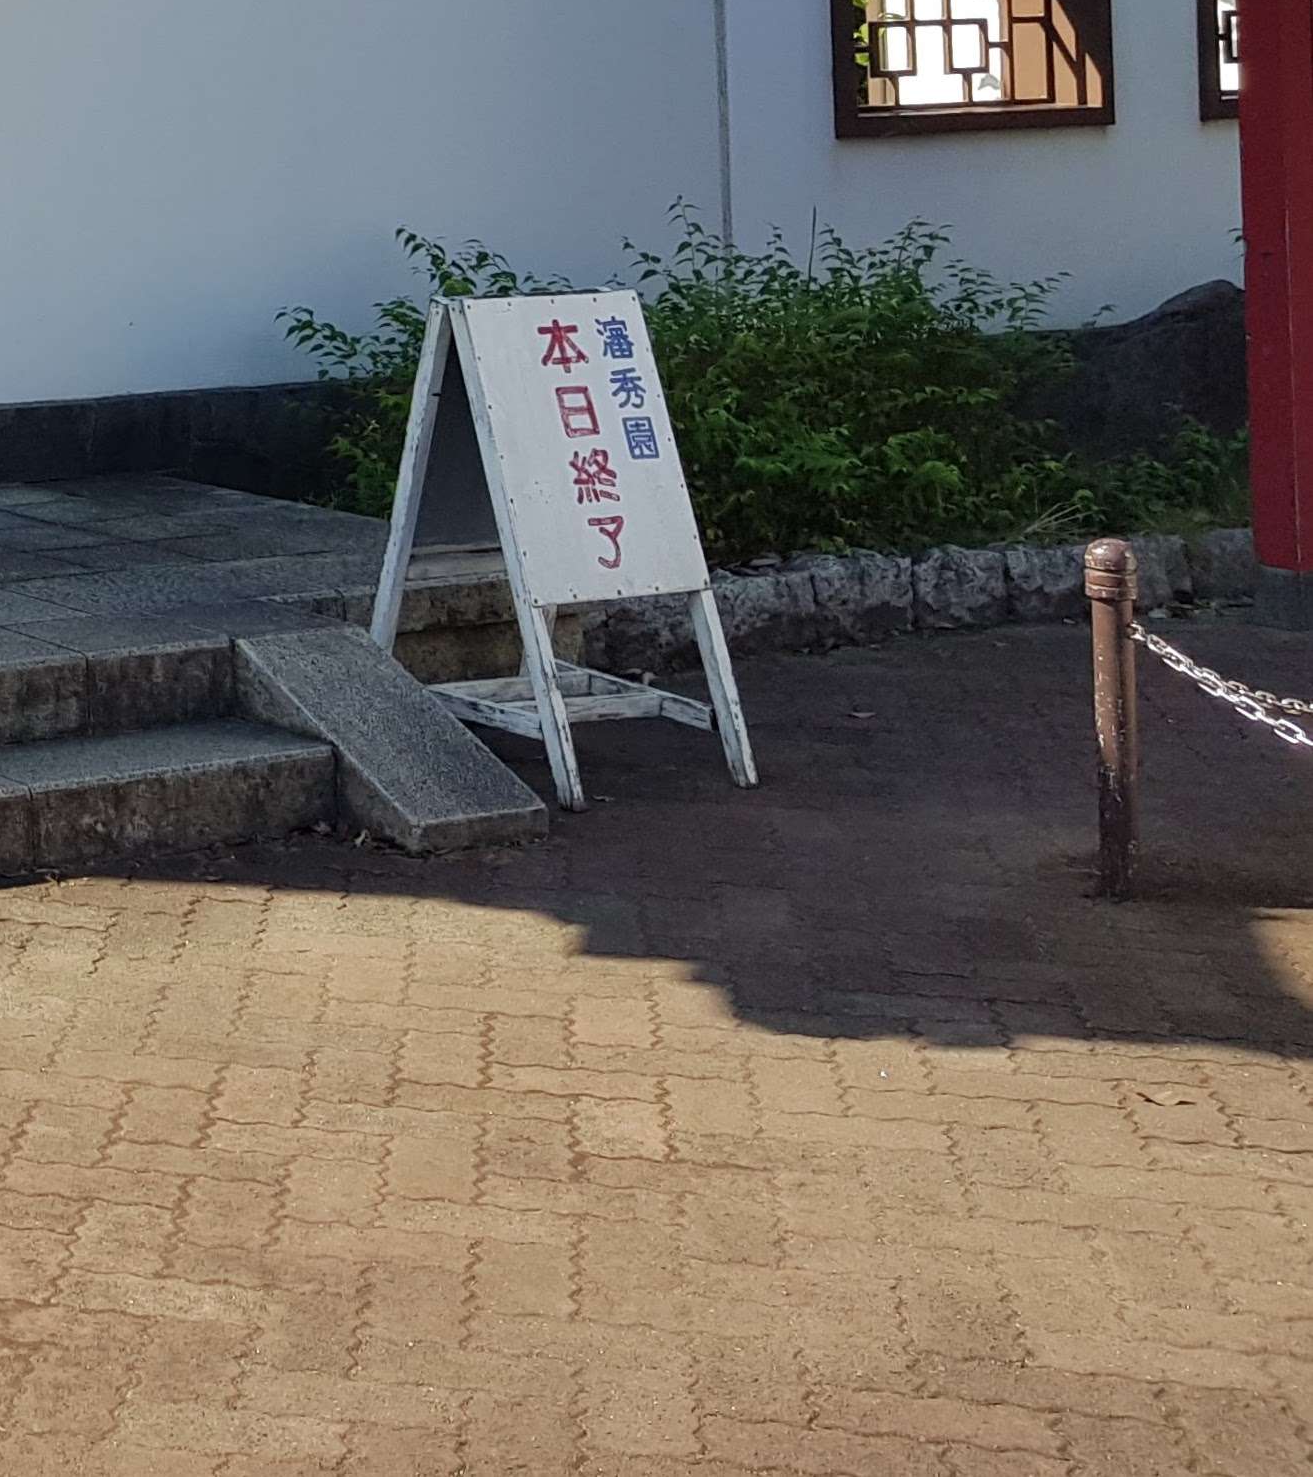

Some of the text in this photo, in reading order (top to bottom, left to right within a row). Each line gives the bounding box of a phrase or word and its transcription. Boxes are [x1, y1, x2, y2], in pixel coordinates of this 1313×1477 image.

[537, 319, 625, 569] 本日終了
[594, 315, 661, 460] 瀋秀園
